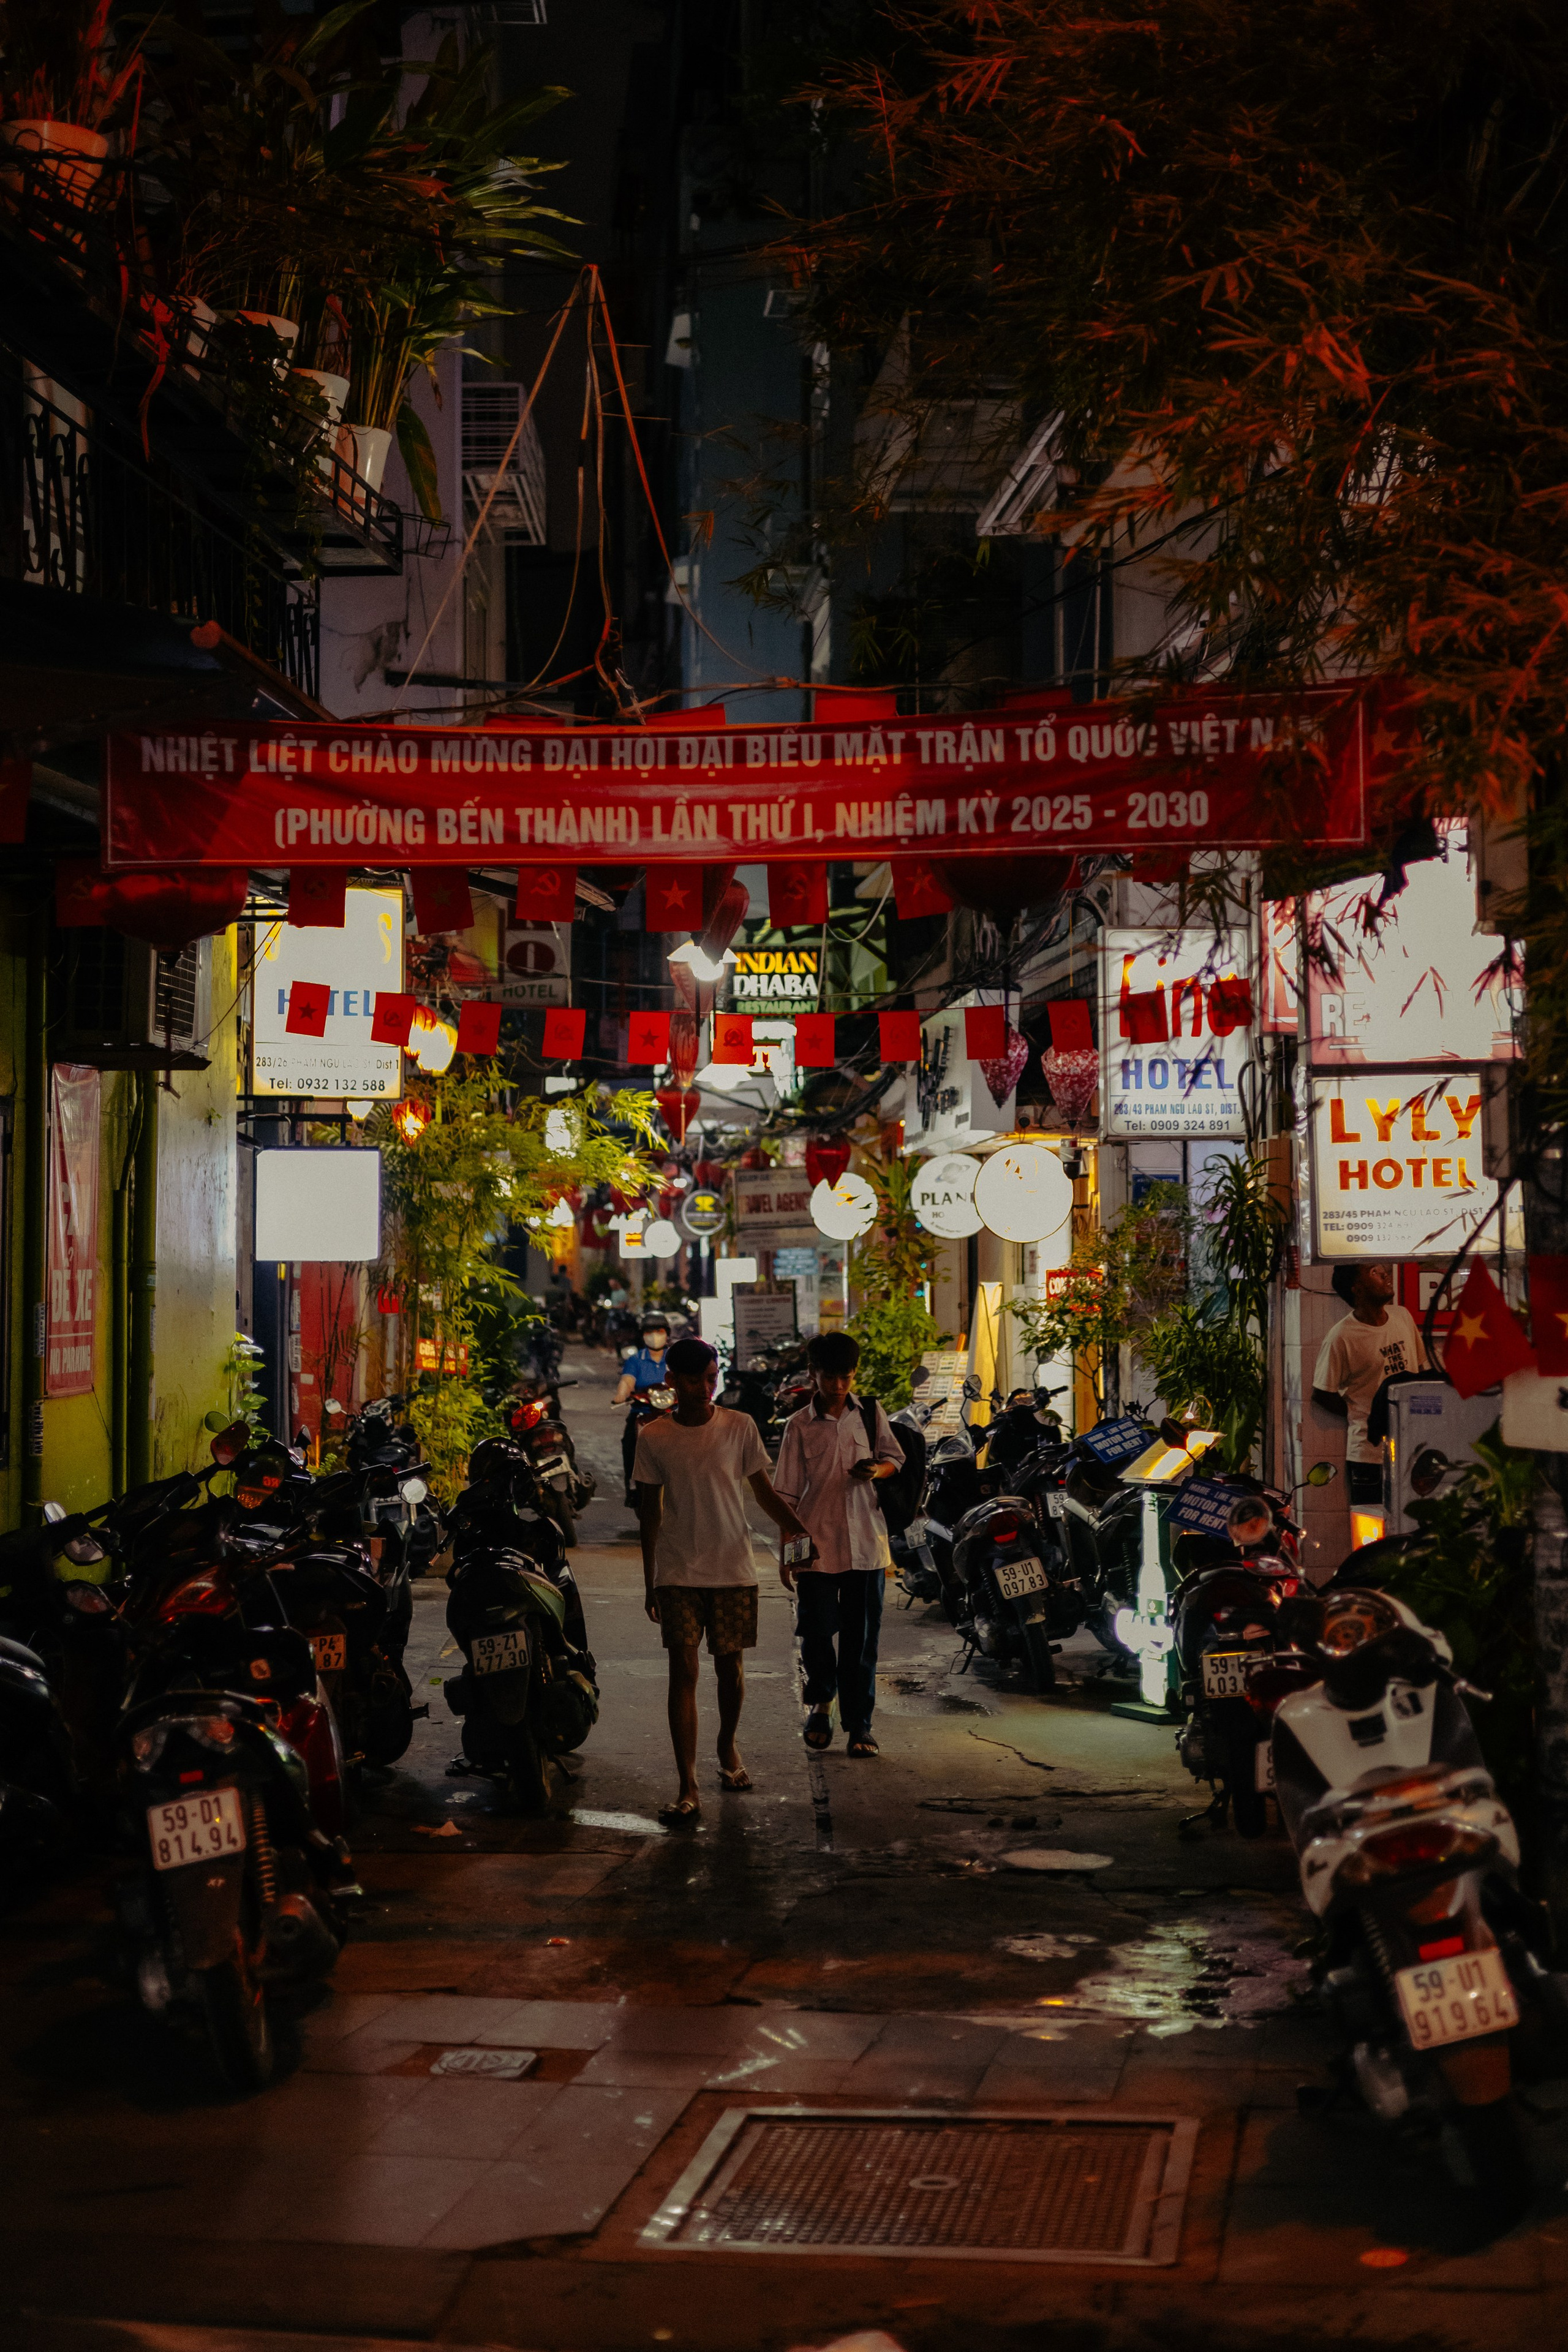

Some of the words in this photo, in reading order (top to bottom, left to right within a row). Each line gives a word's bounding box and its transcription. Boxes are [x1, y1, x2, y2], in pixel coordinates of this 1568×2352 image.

[141, 731, 238, 780] NHIỆT
[249, 733, 317, 781] LIỆT
[328, 732, 418, 773] CHÀO
[430, 734, 532, 773] MỪNG
[543, 738, 600, 779] ĐẠI
[612, 734, 667, 778] HỘI
[677, 736, 734, 777] ĐẠI
[834, 725, 906, 774] MẶT
[916, 722, 1005, 772] TRẬN
[1014, 712, 1057, 762] TỔ
[1169, 712, 1240, 763] VIỆT
[274, 799, 426, 849] (PHƯỜNG
[436, 796, 504, 845] BẾN
[515, 799, 639, 846] THÀNH)
[652, 792, 718, 843] LẦN
[728, 795, 795, 841] THỨ
[835, 793, 946, 845] NHIỆM
[957, 790, 1001, 835] KỲ
[1011, 794, 1093, 832] 2025
[1104, 809, 1116, 818] -
[1127, 790, 1209, 829] 2030
[735, 952, 818, 974] INDIAN
[502, 984, 557, 998] HOTEL
[733, 974, 818, 997] DHABA
[320, 1057, 340, 1068] NGU
[376, 1058, 392, 1070] Dist
[1121, 1058, 1234, 1090] HOTEL
[269, 1077, 292, 1090] Tel:
[297, 1078, 329, 1090] 0932
[335, 1079, 356, 1091] 132
[362, 1079, 385, 1091] 588
[1114, 1104, 1142, 1115] 283/43
[1145, 1104, 1167, 1114] PHAM
[1170, 1104, 1185, 1114] NGU
[1188, 1104, 1202, 1114] LAO
[1329, 1094, 1482, 1144] LYLY
[1125, 1120, 1146, 1131] Tel:
[1150, 1120, 1179, 1131] 0909
[1184, 1120, 1205, 1131] 324
[1209, 1120, 1230, 1131] 891
[1339, 1157, 1477, 1191] HOTEL
[1322, 1210, 1358, 1219] 283/45
[1360, 1210, 1390, 1219] PHAM
[1420, 1208, 1440, 1216] LAO
[1323, 1223, 1344, 1232] TEL:
[1346, 1222, 1374, 1231] 0909
[1346, 1234, 1374, 1243] 0909
[50, 1348, 61, 1375] NO
[62, 1345, 91, 1374] PARKING
[1379, 1341, 1406, 1358] WHAT
[1388, 1352, 1403, 1363] THE
[1093, 1434, 1125, 1450] MOTOR
[1121, 1427, 1142, 1439] BIKE
[1106, 1444, 1125, 1457] FOR
[1121, 1436, 1144, 1450] RENT
[1179, 1493, 1219, 1512] MOTOR
[1177, 1507, 1200, 1522] FOR
[1198, 1512, 1228, 1531] RENT
[1002, 1562, 1035, 1581] 59-U1
[1004, 1574, 1044, 1596] 097.83
[478, 1634, 518, 1656] 59-Z1
[476, 1649, 527, 1674] 477.30
[162, 1796, 222, 1833] 59-D1
[158, 1822, 238, 1863] 814.94
[1414, 1959, 1487, 2003] 59-U1
[1415, 1992, 1509, 2041] 919.64
